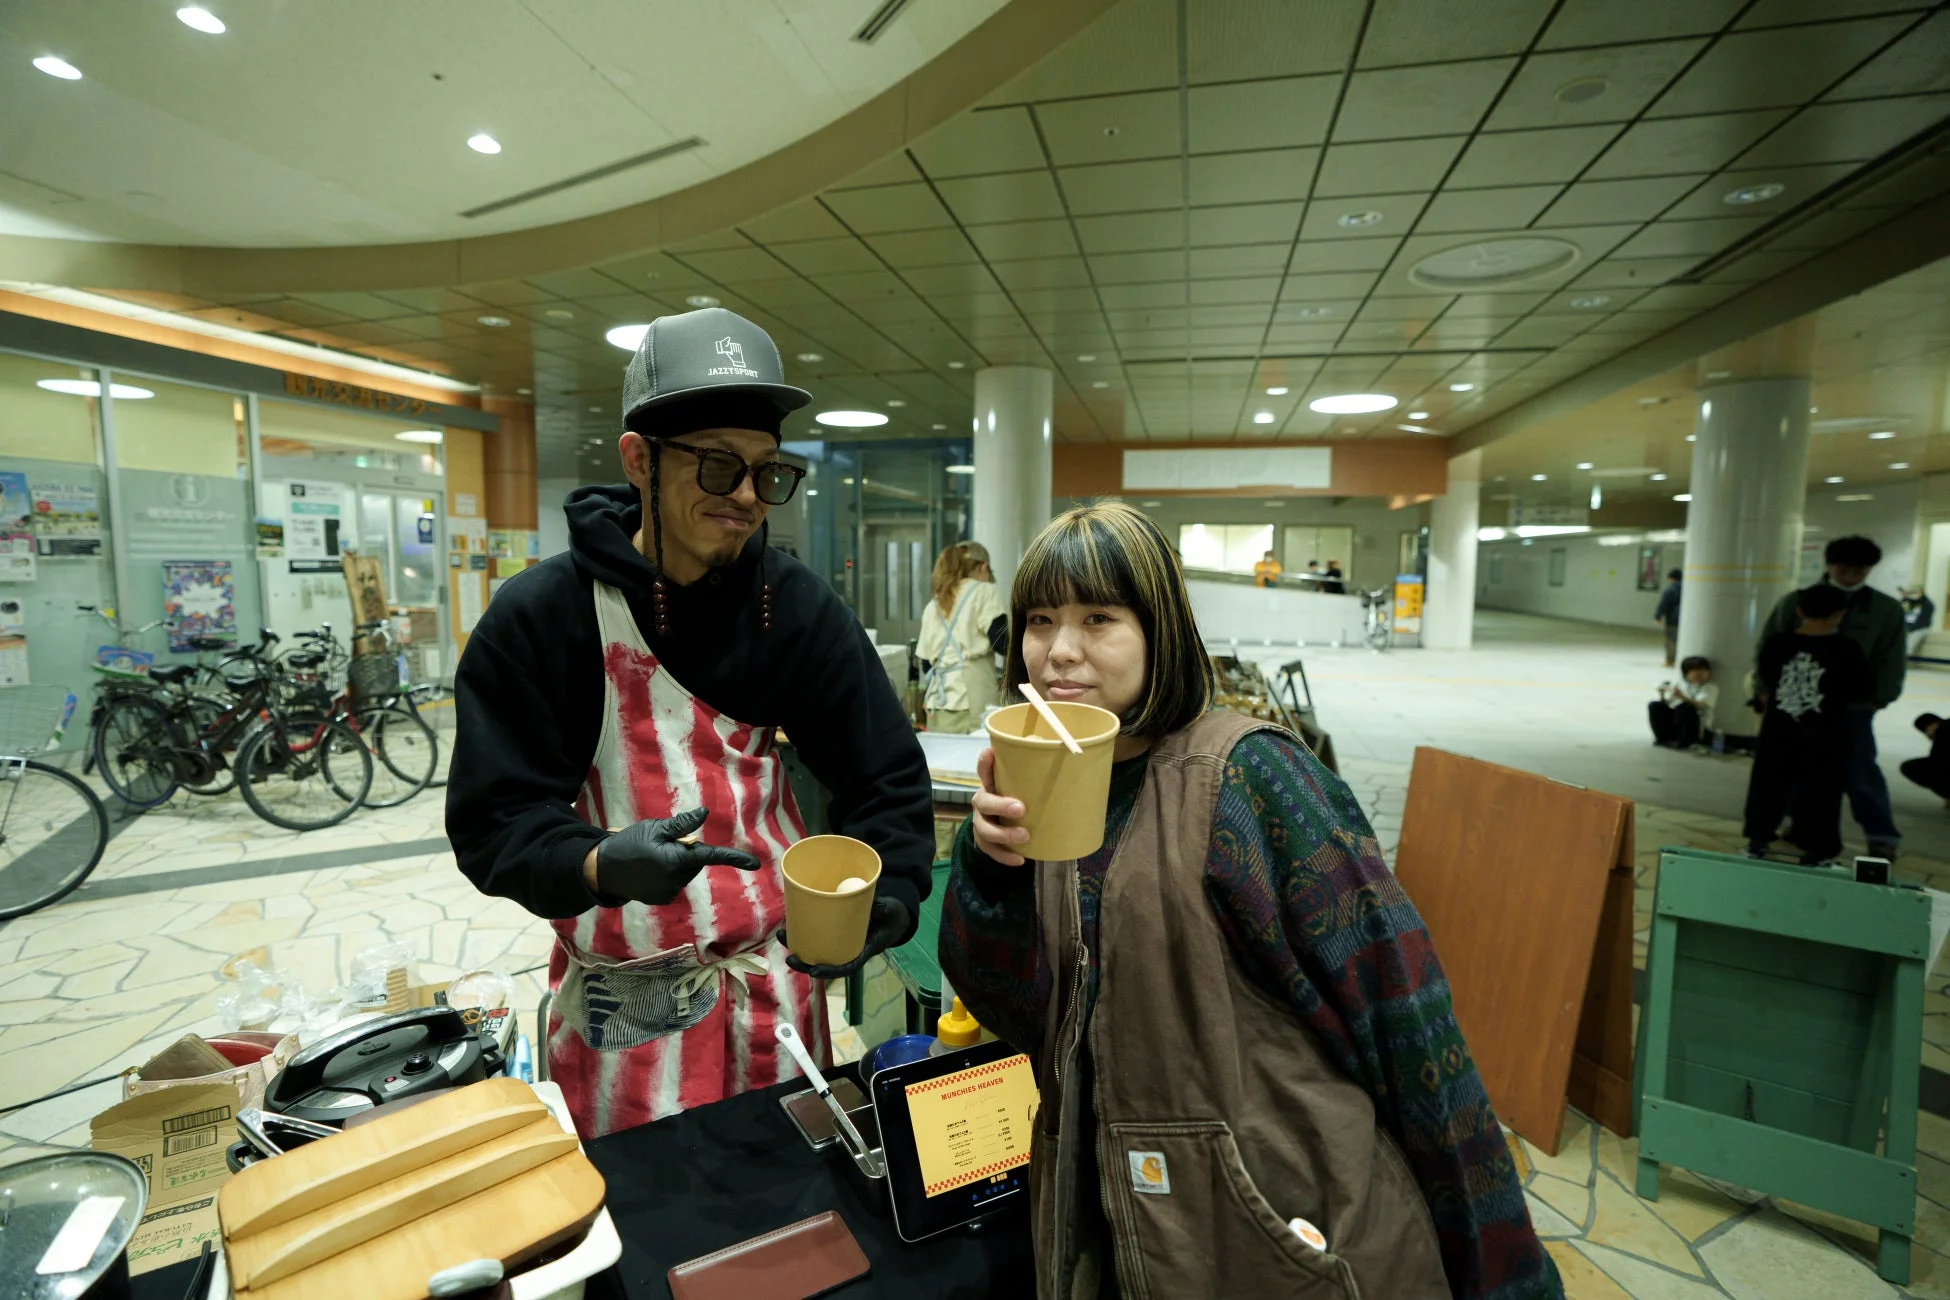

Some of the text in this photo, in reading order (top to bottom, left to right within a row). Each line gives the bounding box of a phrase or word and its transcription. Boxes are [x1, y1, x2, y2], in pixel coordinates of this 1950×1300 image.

[708, 367, 758, 378] JAZZYSPORT
[941, 1077, 1004, 1101] MUNCHIES HEAVEN
